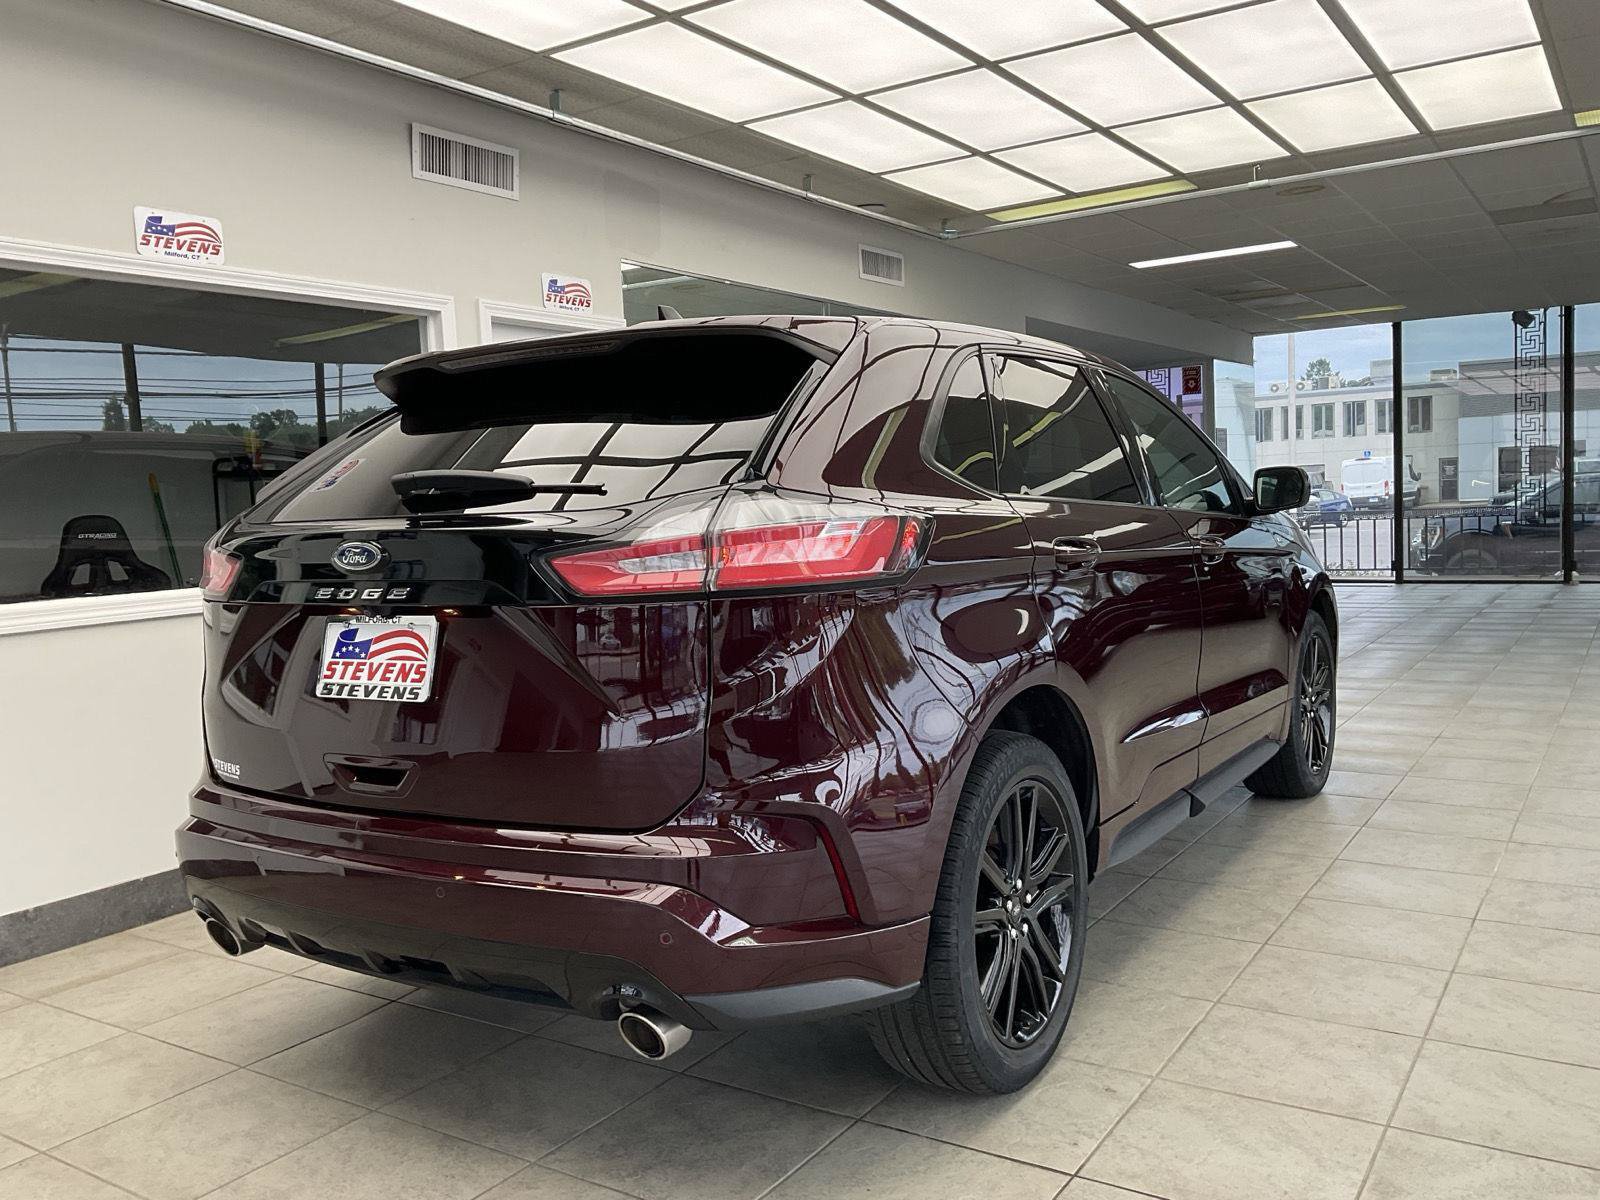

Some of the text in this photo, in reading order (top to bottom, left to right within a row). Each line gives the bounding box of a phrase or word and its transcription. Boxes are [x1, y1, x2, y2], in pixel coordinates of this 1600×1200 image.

[139, 234, 222, 256] STEVENS
[164, 250, 189, 260] Milford,
[545, 292, 592, 308] STEVENS
[342, 547, 368, 564] Ford
[314, 587, 411, 599] EDGE
[391, 615, 402, 624] CT
[323, 660, 427, 684] STEVENS
[320, 682, 422, 700] STEVENS
[214, 758, 241, 775] STEVENS
